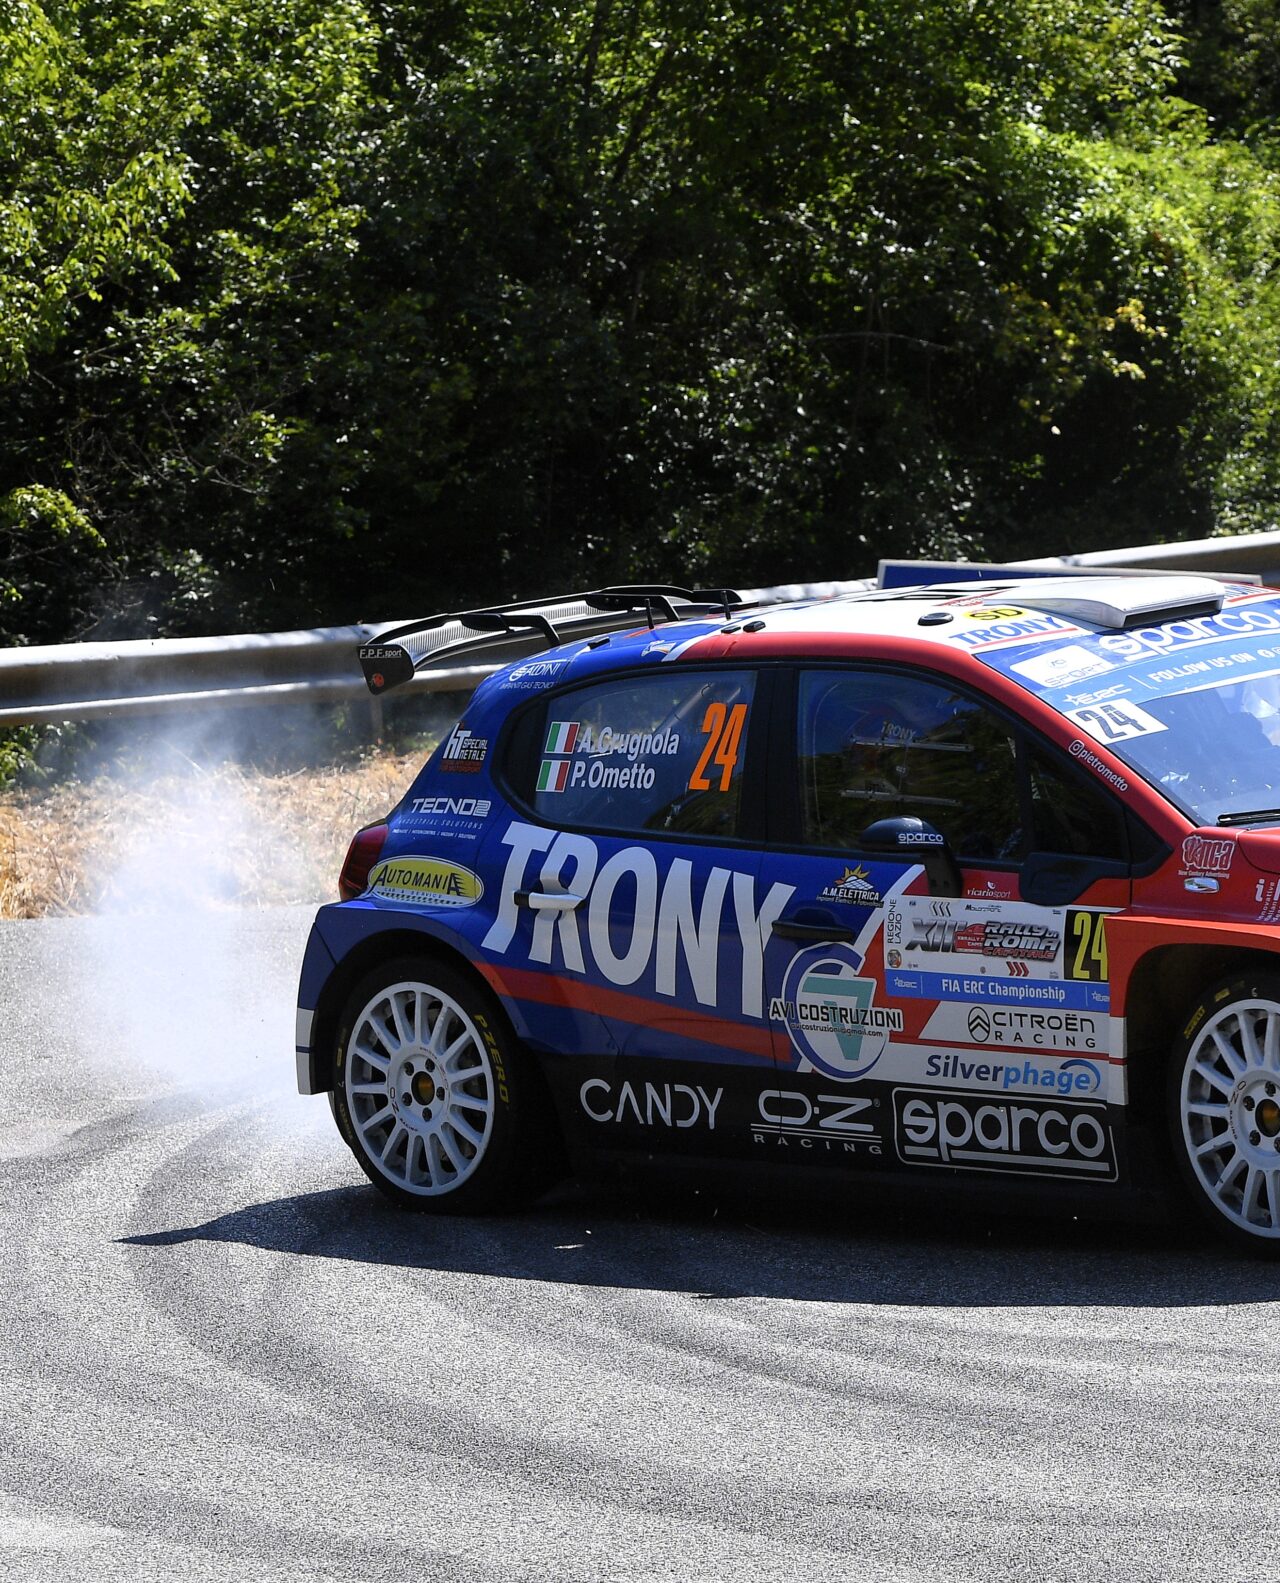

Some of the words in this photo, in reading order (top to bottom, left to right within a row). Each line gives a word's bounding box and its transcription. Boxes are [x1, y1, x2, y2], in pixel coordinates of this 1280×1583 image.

[970, 608, 1023, 621] SD
[949, 616, 1064, 645] TRONY
[1099, 611, 1280, 655] sparco
[1147, 660, 1212, 682] FOLLOW
[1209, 656, 1233, 668] US
[1231, 652, 1256, 664] ON
[1076, 704, 1147, 739] 24
[459, 750, 487, 760] METALS
[462, 739, 488, 750] SPECIAL
[688, 702, 748, 792] 24
[571, 760, 655, 790] P.Ometto
[411, 797, 491, 817] TECNO2
[441, 821, 483, 830] SOLUTIONS
[898, 832, 944, 845] sparco
[368, 864, 464, 895] AUTOMANIA
[481, 820, 797, 1019] TRONY
[887, 899, 897, 944] REGIONE
[895, 913, 903, 944] LAZIO
[985, 922, 1049, 937] RALLY
[983, 934, 1061, 951] ROMA
[983, 947, 1056, 960] CAPITALE
[1073, 912, 1107, 980] 24
[942, 978, 961, 994] FIA
[964, 980, 985, 995] ERC
[988, 982, 1066, 1003] Championship
[771, 1001, 795, 1019] AVI
[799, 1003, 902, 1029] COSTRUZIONI
[994, 1030, 1096, 1048] RACING
[926, 1054, 1092, 1094] Silverphage
[579, 1078, 724, 1130] CANDY
[754, 1132, 882, 1155] RACING
[902, 1099, 1105, 1162] sparco
